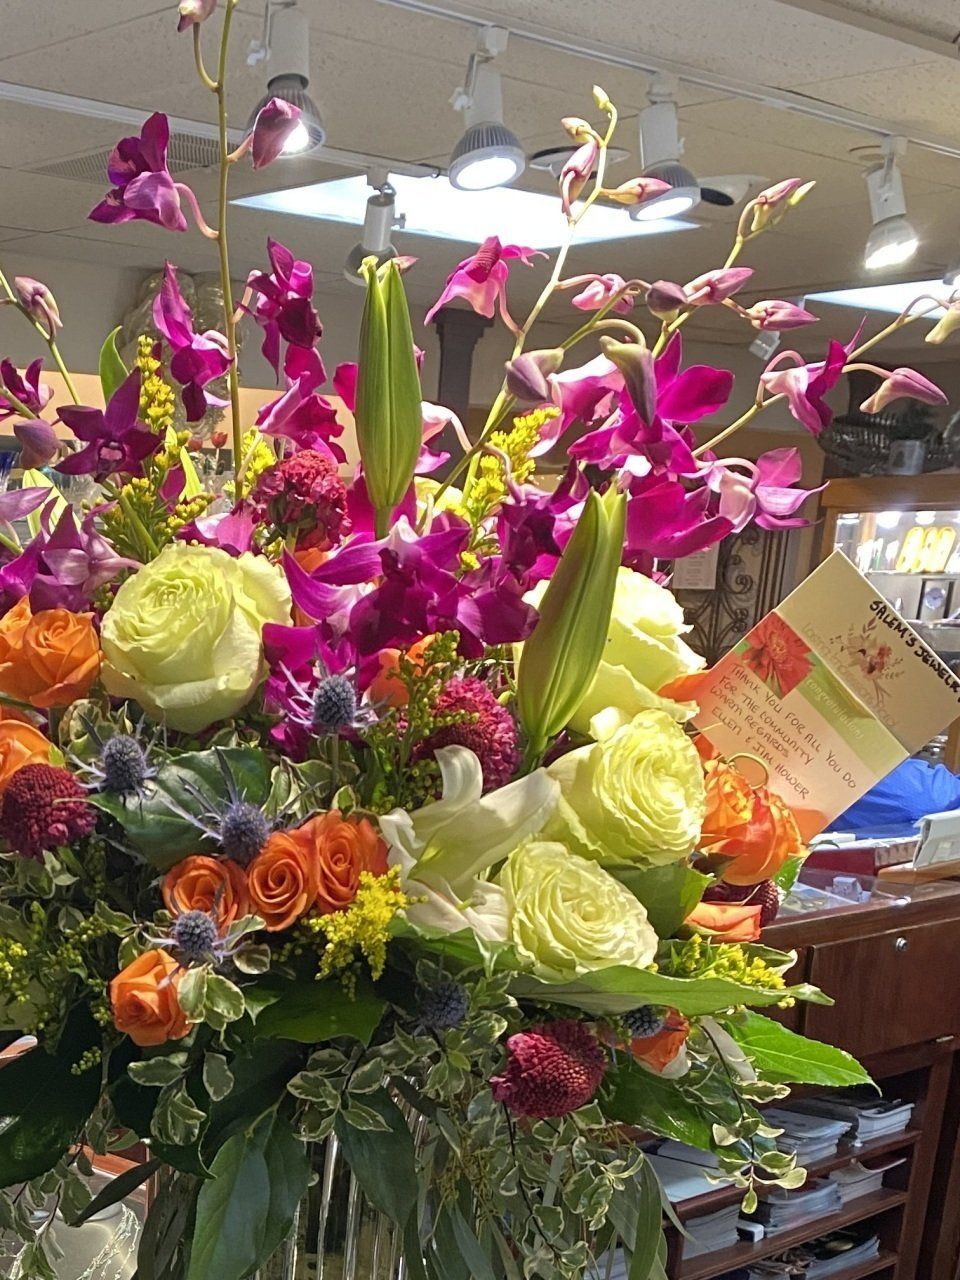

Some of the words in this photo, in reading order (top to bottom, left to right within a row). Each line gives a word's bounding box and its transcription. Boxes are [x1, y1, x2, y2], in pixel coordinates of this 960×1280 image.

[869, 600, 916, 648] SALEM'S
[913, 645, 960, 703] JEWELR
[710, 685, 743, 716] WARM
[744, 714, 790, 759] REGARDS
[711, 706, 742, 736] ELLEN
[752, 741, 774, 765] JIM
[719, 675, 738, 696] FOR
[741, 692, 760, 716] THE
[759, 710, 815, 767] COMMUNITY
[731, 663, 761, 694] THANK
[765, 691, 783, 714] YOU
[784, 711, 806, 735] FOR
[804, 732, 822, 753] ALL
[825, 749, 842, 774] YOU
[843, 771, 857, 790] DO
